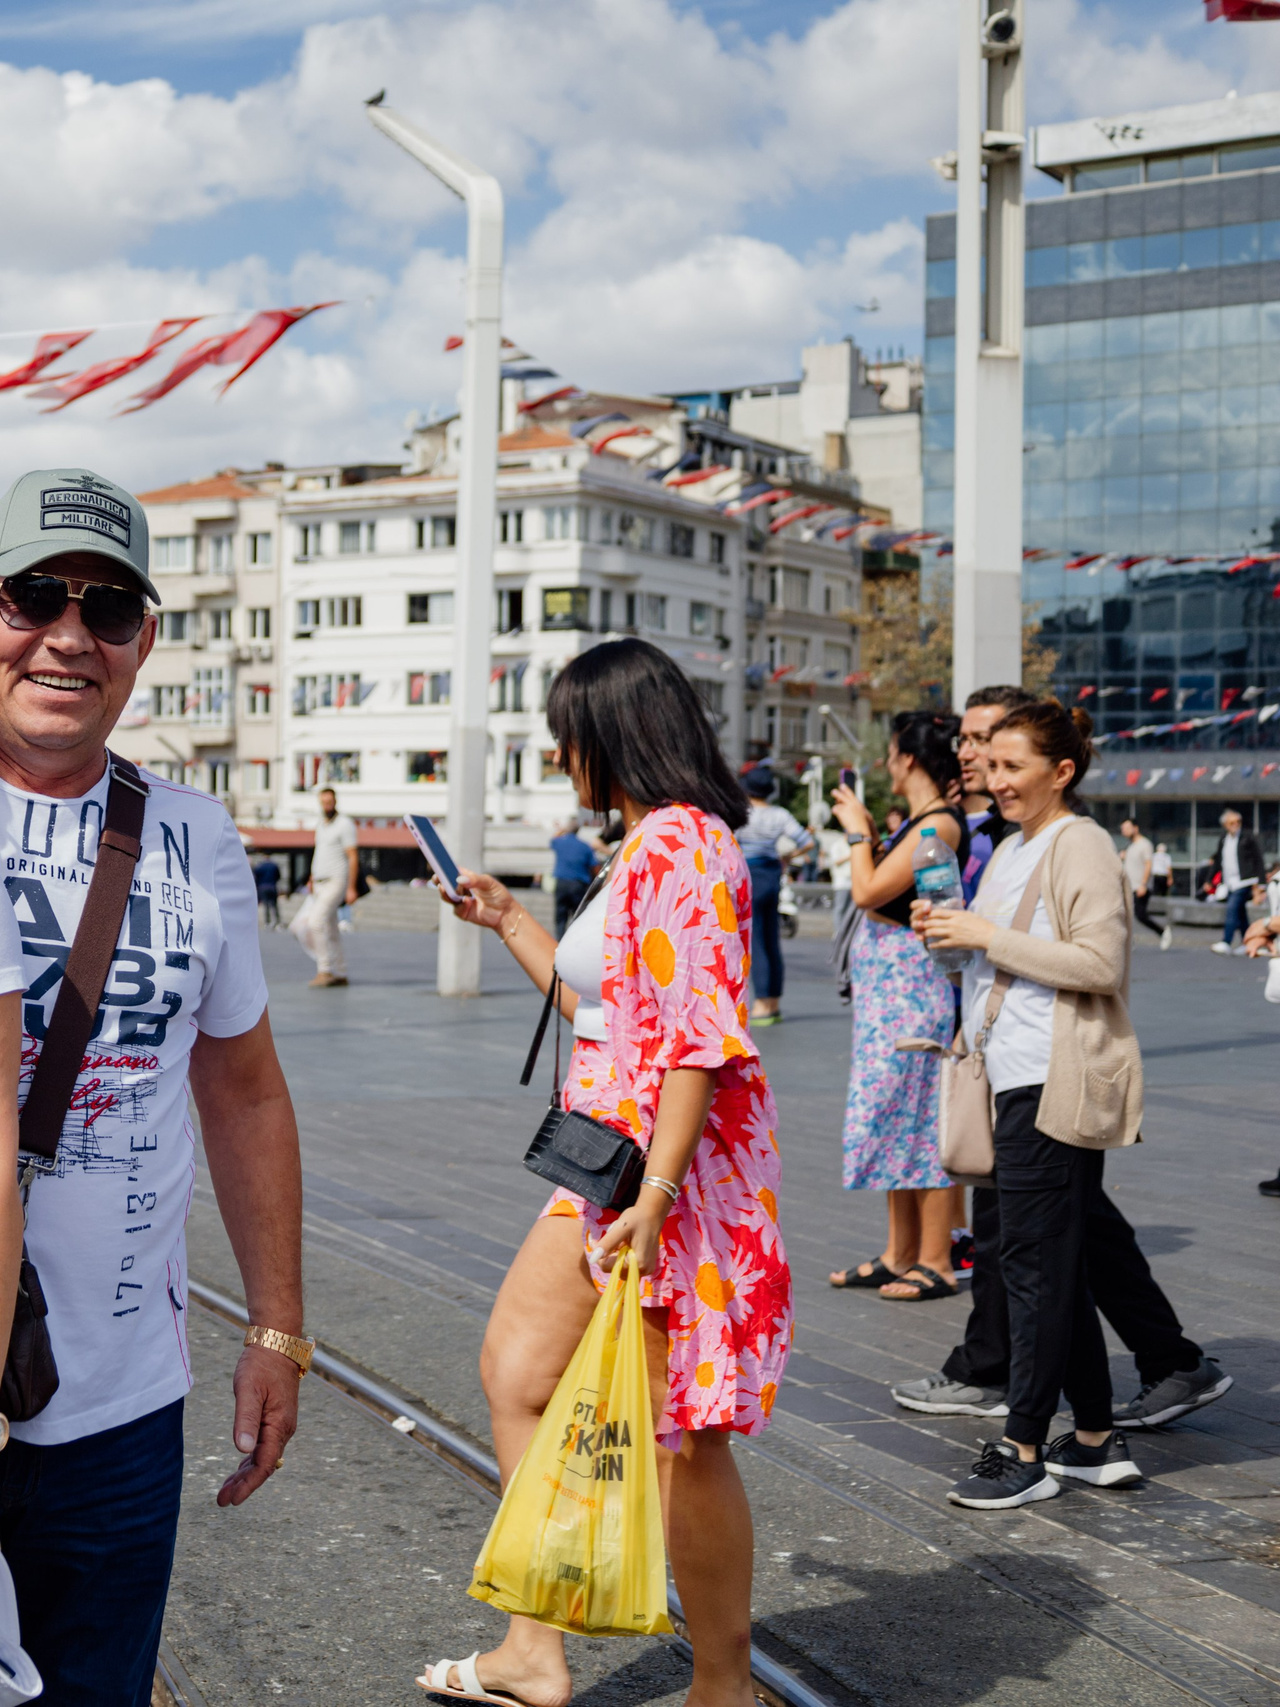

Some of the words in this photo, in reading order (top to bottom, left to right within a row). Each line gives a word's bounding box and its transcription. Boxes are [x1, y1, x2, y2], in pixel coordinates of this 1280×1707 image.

[48, 492, 125, 518] AERONAUTICA
[61, 513, 114, 533] MILITARE
[6, 857, 89, 886] ORIGINAL
[161, 882, 194, 914] REG
[158, 908, 195, 952] TM
